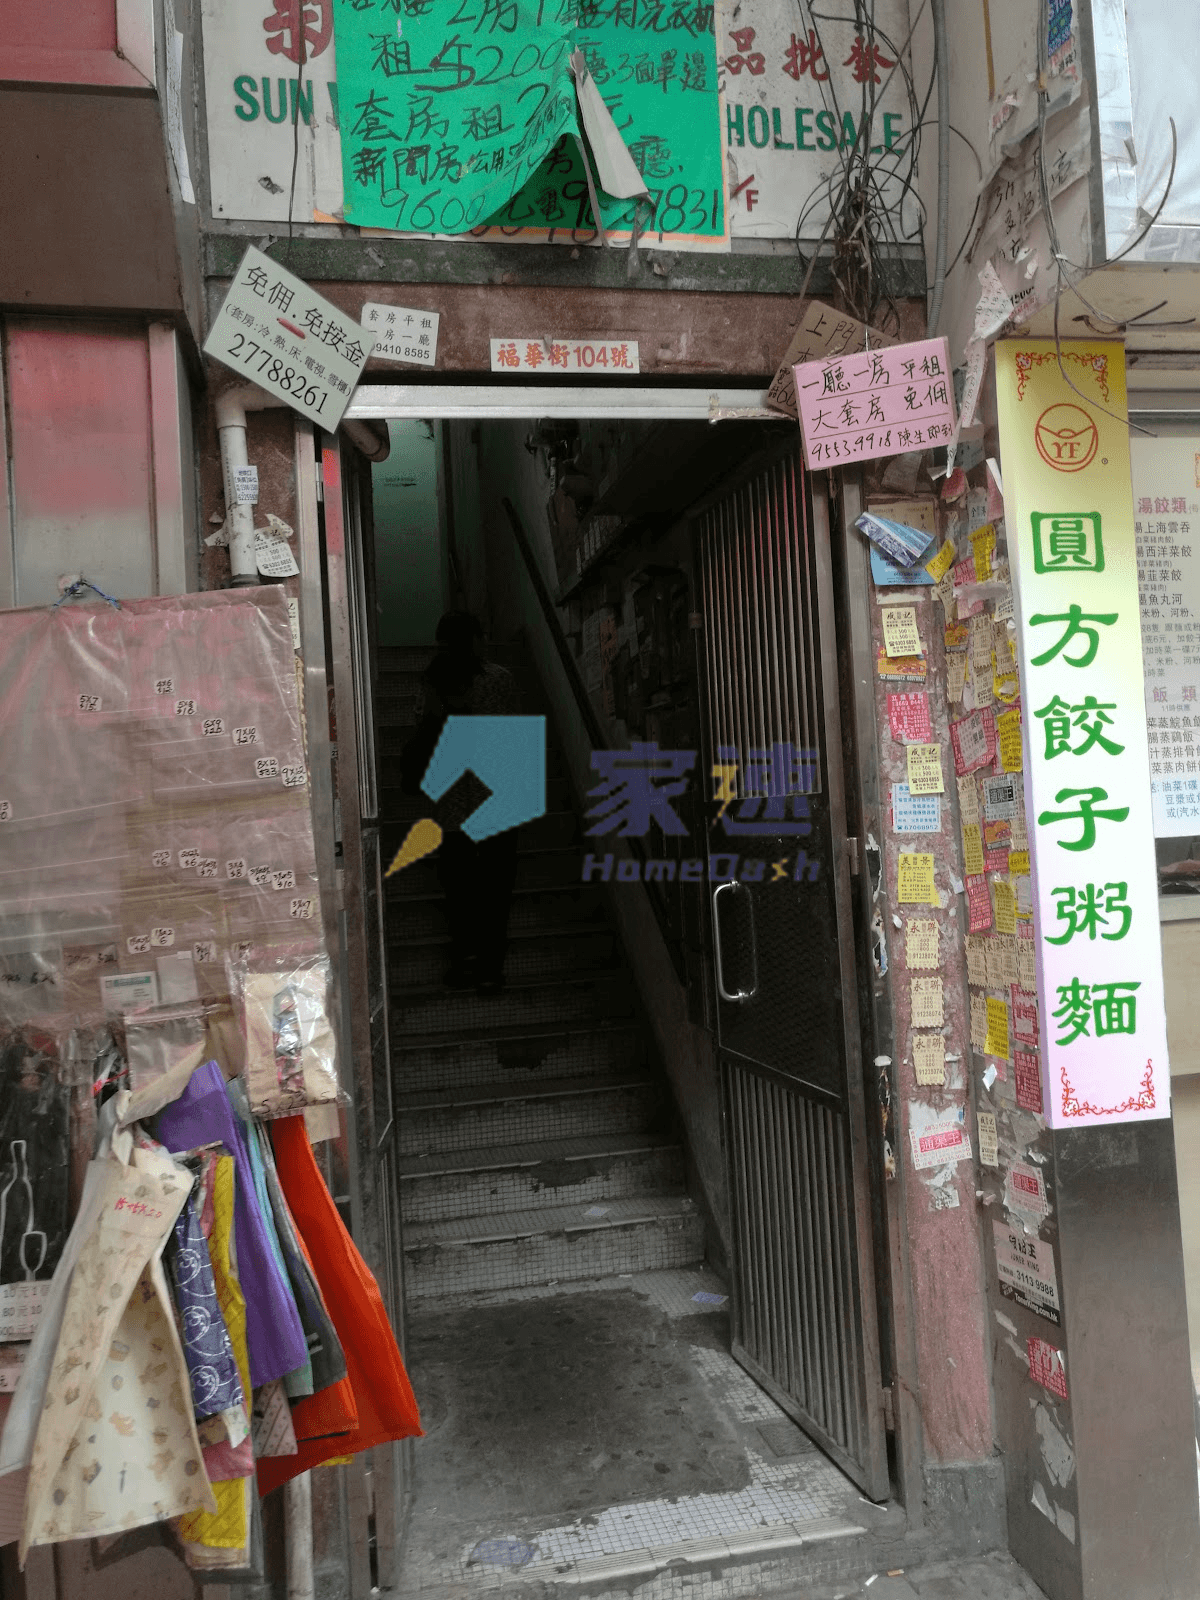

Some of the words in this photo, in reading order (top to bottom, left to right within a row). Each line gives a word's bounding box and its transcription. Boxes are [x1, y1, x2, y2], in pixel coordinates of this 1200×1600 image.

[233, 75, 315, 126] SUN
[369, 310, 432, 329] 套房平租
[368, 329, 430, 347] 一房一廳
[375, 342, 401, 355] 9410
[404, 347, 430, 360] 8585
[497, 342, 634, 368] 福華街104號
[227, 334, 329, 415] 27788261
[802, 353, 889, 395] 一廳一房
[901, 355, 945, 378] 平租
[812, 394, 885, 433] 大套房
[1138, 497, 1187, 514] 湯餃類
[1029, 511, 1141, 1046] 圓方餃子粥麵
[1016, 1269, 1034, 1287] 3113
[1035, 1280, 1054, 1297] 9988
